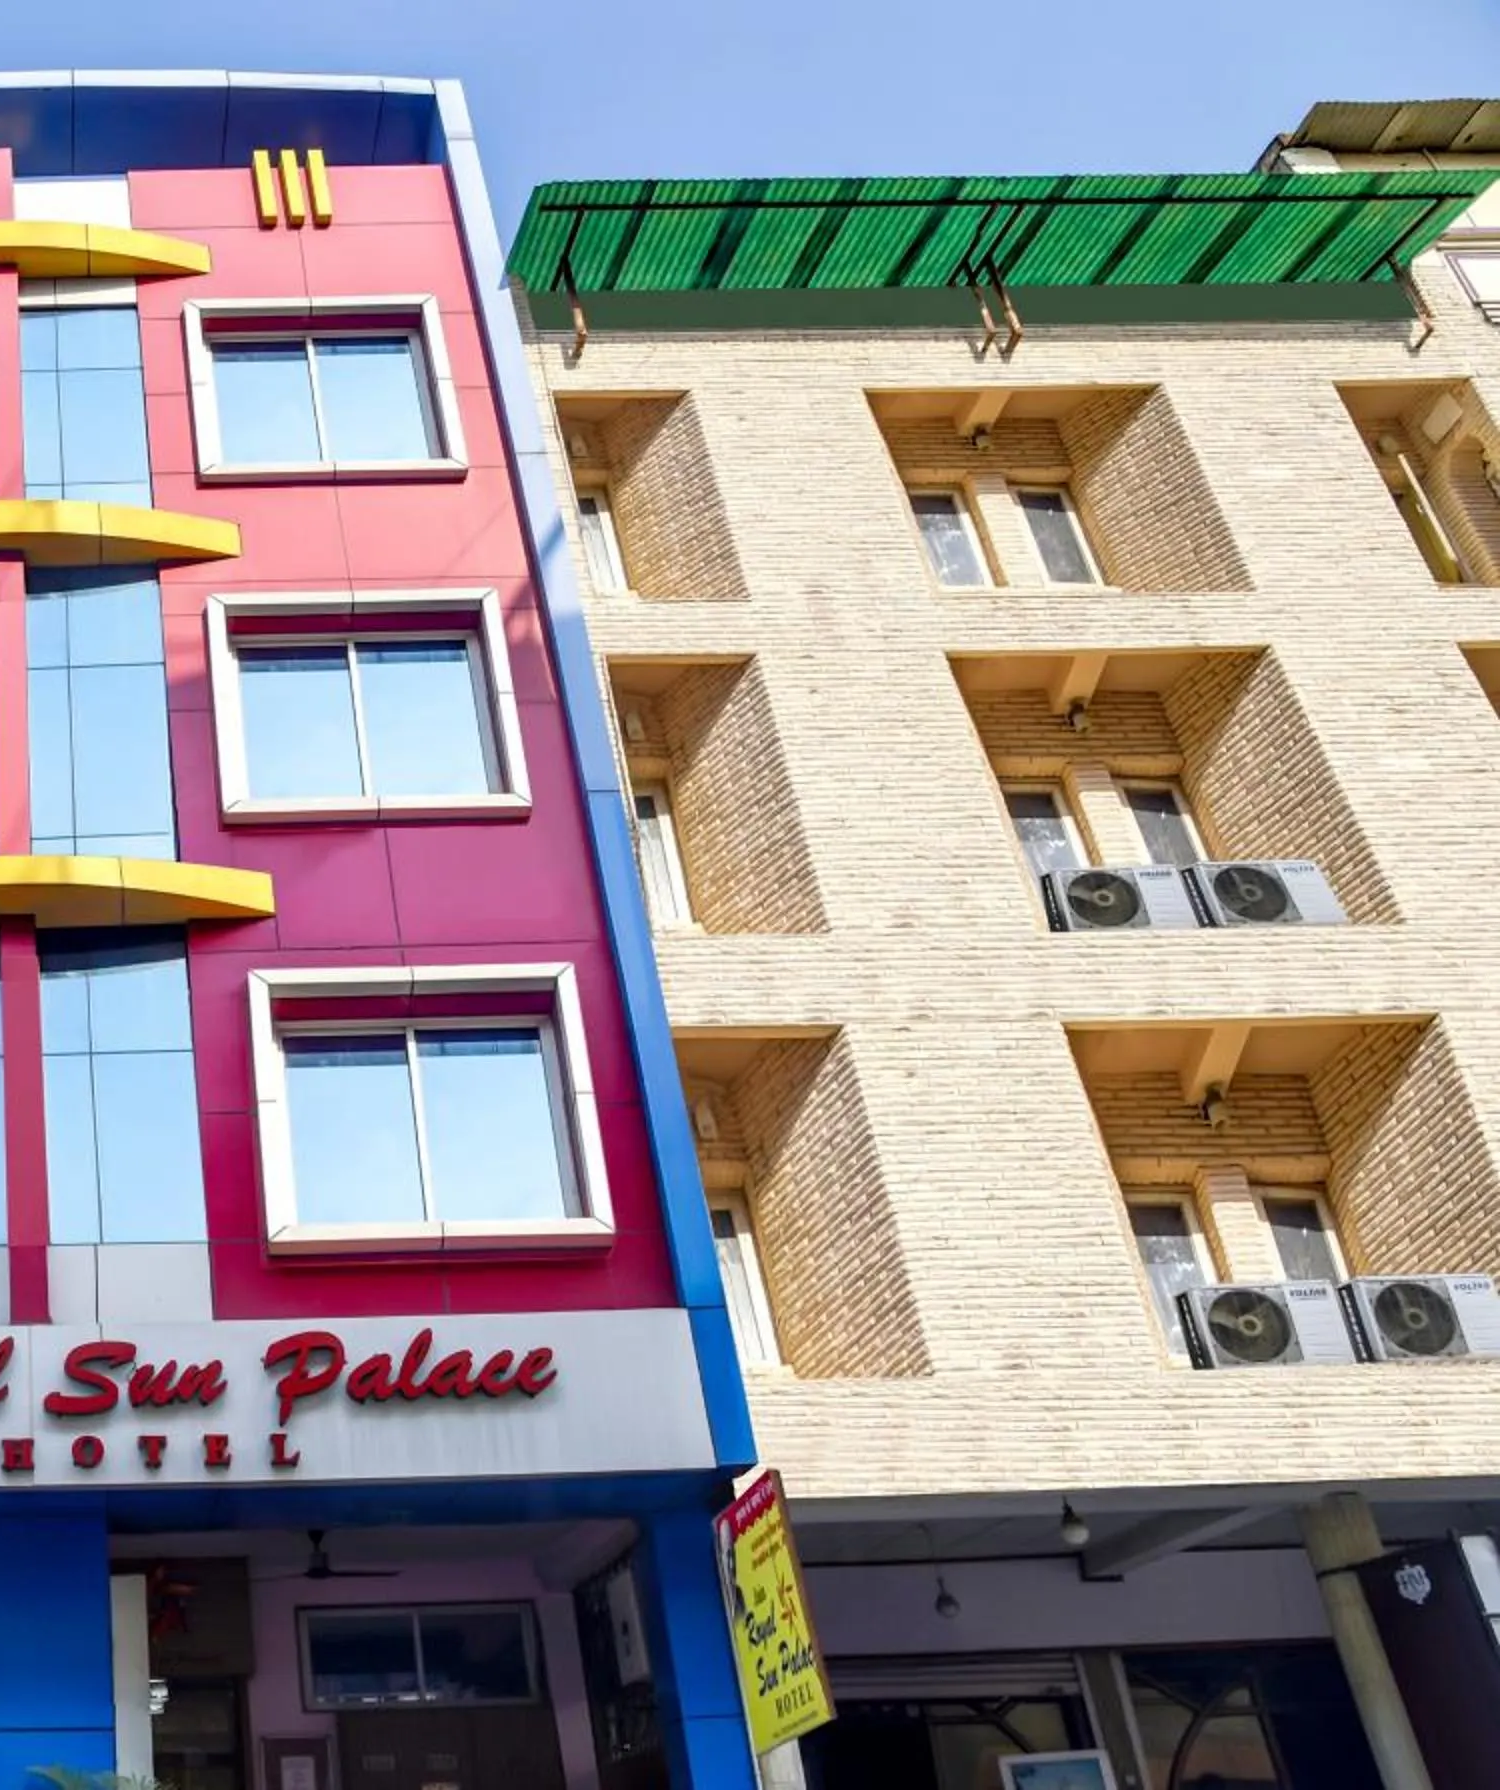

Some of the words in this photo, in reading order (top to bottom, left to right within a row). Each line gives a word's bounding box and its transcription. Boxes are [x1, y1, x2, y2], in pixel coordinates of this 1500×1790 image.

[44, 1341, 228, 1417] Sun
[261, 1328, 558, 1427] Palace
[1, 1434, 300, 1471] HOTEL
[775, 1682, 815, 1719] HOTEL
